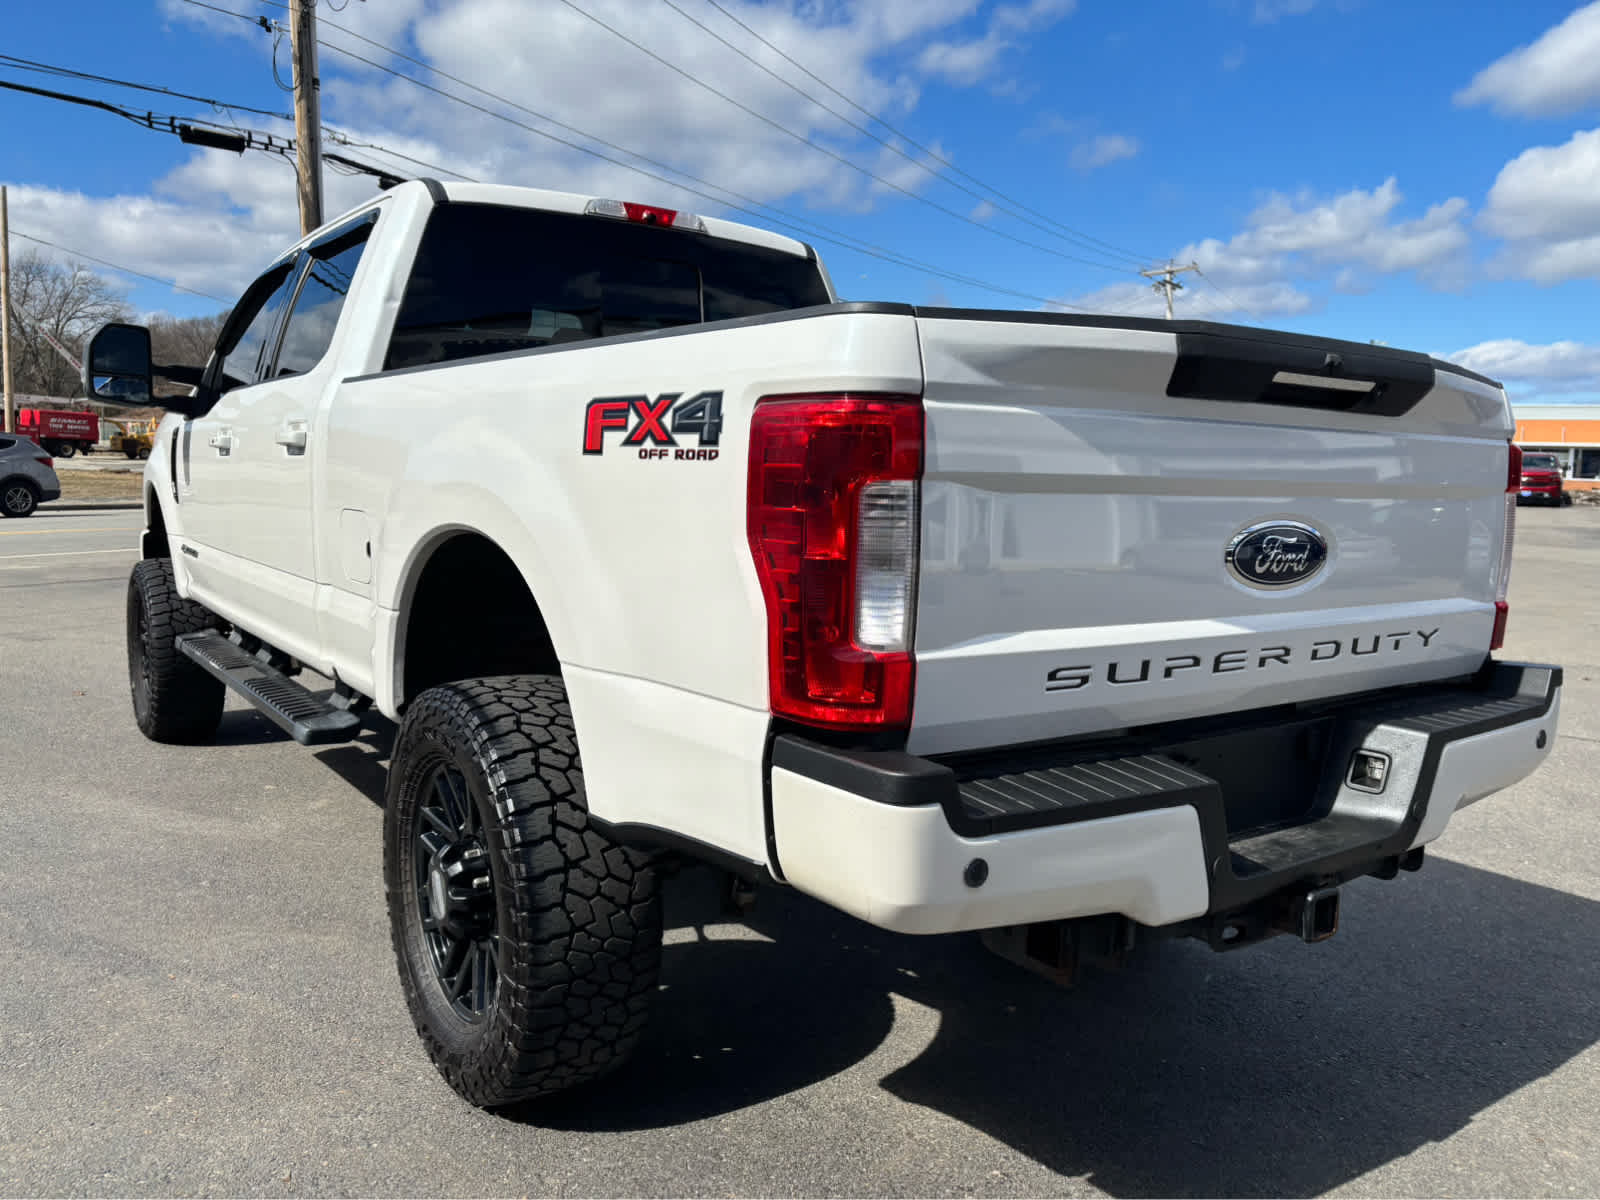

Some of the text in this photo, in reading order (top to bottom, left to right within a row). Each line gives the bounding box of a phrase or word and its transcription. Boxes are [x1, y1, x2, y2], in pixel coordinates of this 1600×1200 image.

[582, 390, 725, 456] FX4
[638, 448, 720, 461] OFF ROAD
[1255, 535, 1311, 574] Ford
[1045, 628, 1440, 693] SUPER DUTY
